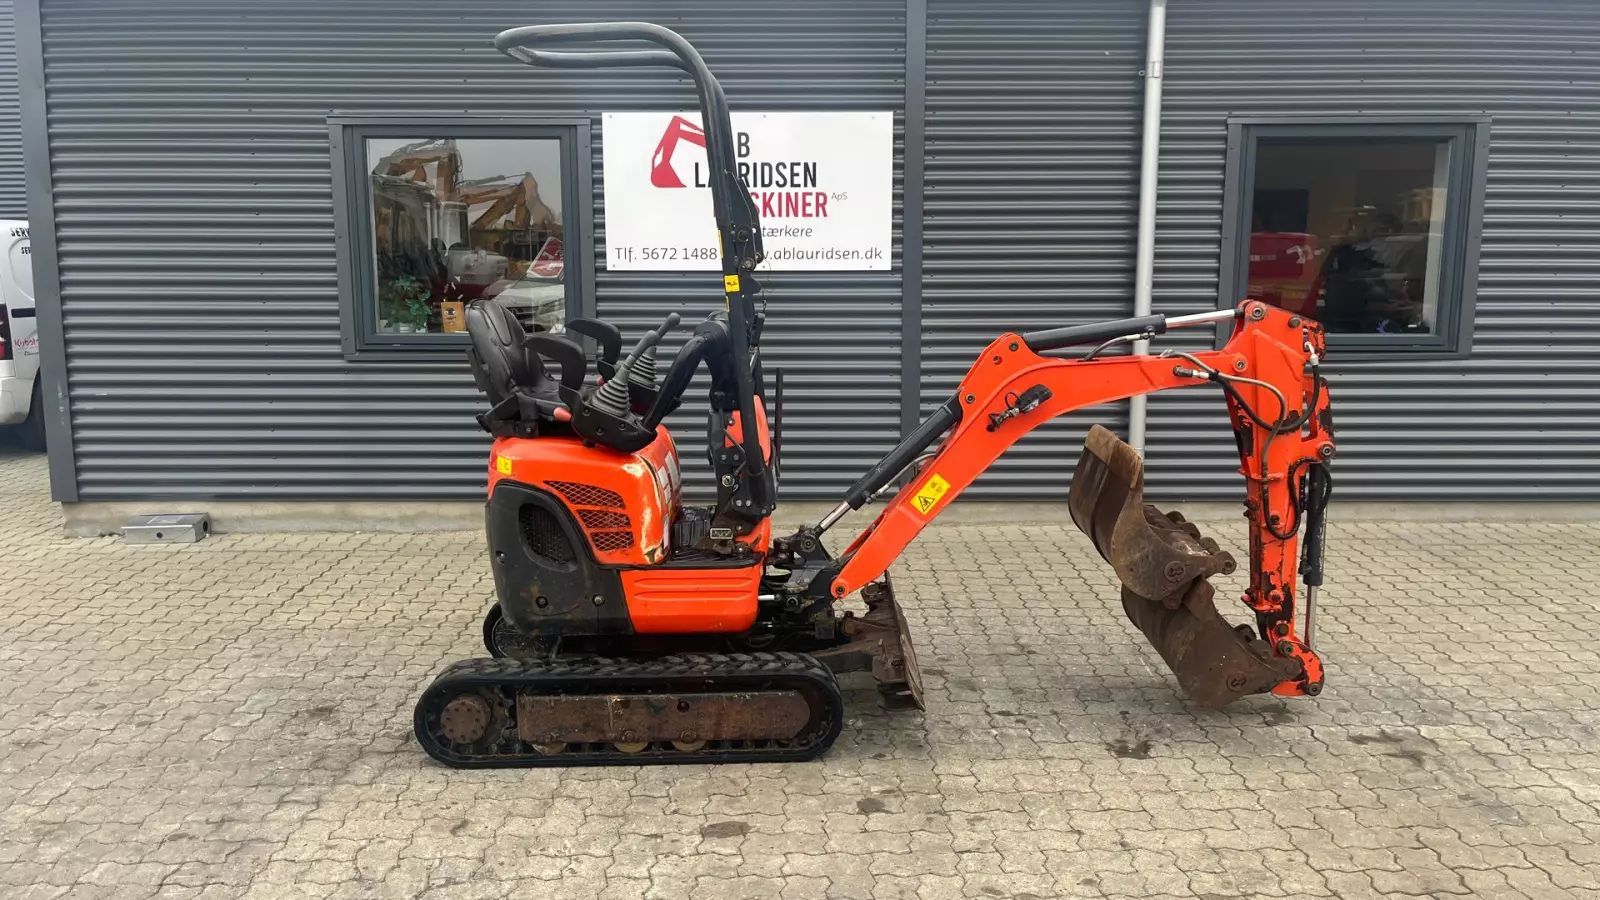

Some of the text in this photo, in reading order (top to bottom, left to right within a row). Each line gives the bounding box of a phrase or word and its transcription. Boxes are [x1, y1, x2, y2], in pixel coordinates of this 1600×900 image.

[694, 162, 817, 188] LRIDSEN
[831, 192, 848, 201] ApS
[762, 225, 813, 238] tærkere
[615, 247, 637, 263] Tlf.
[642, 247, 678, 260] 5672
[682, 247, 718, 260] 1488
